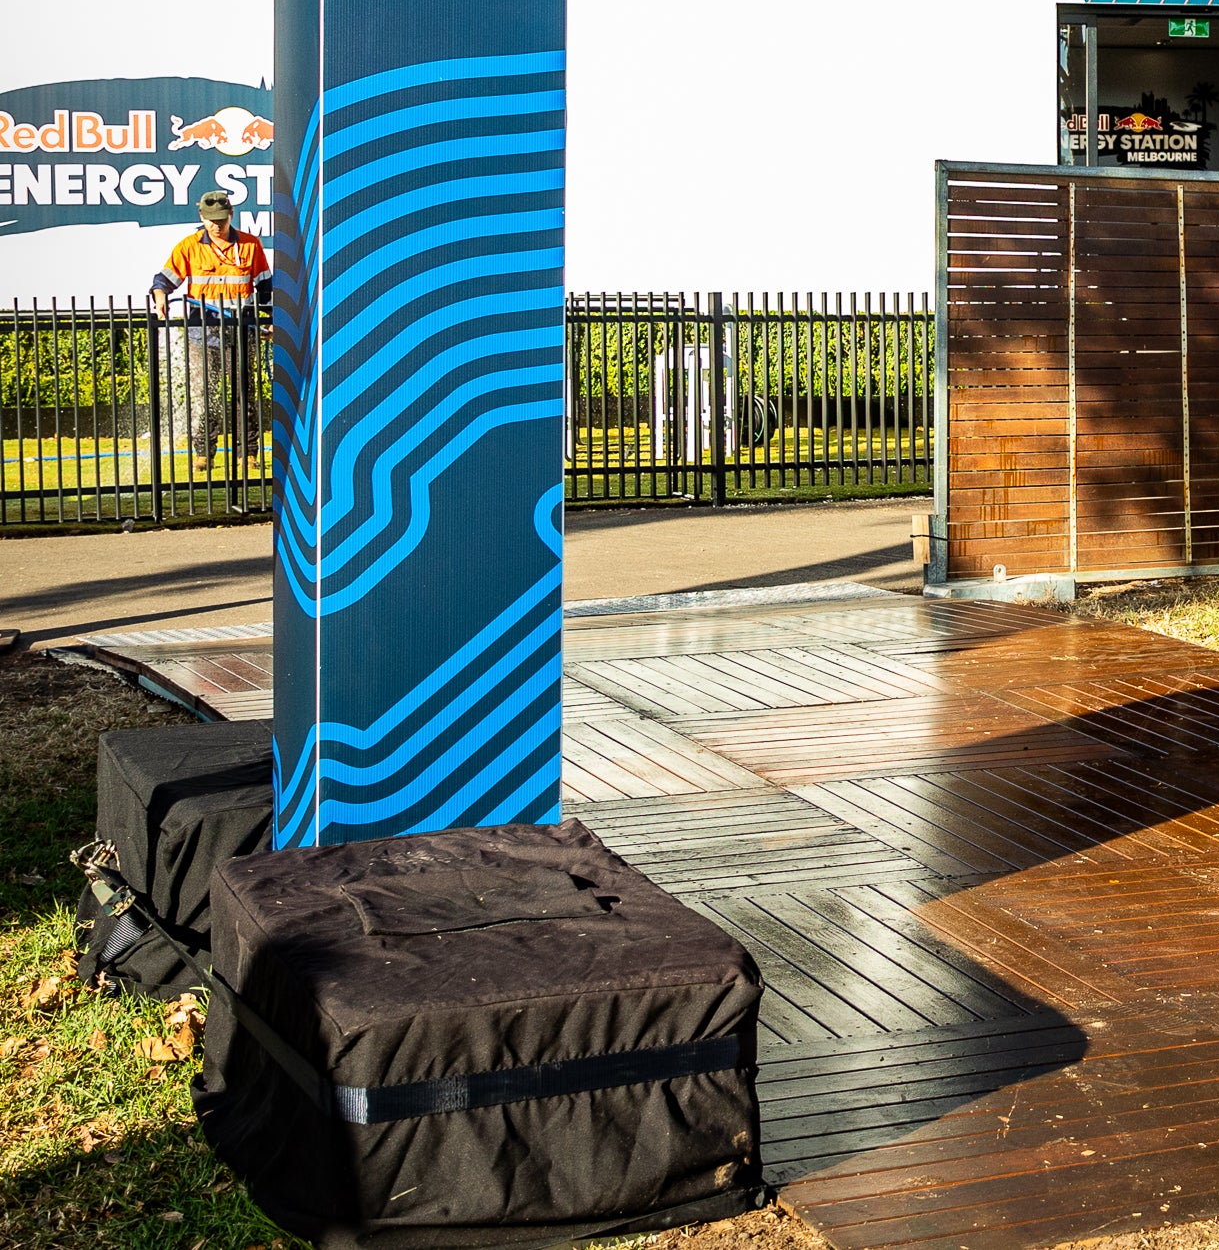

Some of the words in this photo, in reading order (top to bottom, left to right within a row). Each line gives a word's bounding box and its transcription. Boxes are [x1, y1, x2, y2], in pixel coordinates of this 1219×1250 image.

[76, 114, 152, 150] Bull
[1120, 134, 1198, 151] STATION
[1127, 152, 1198, 163] MELBOURNE
[240, 210, 274, 237] M
